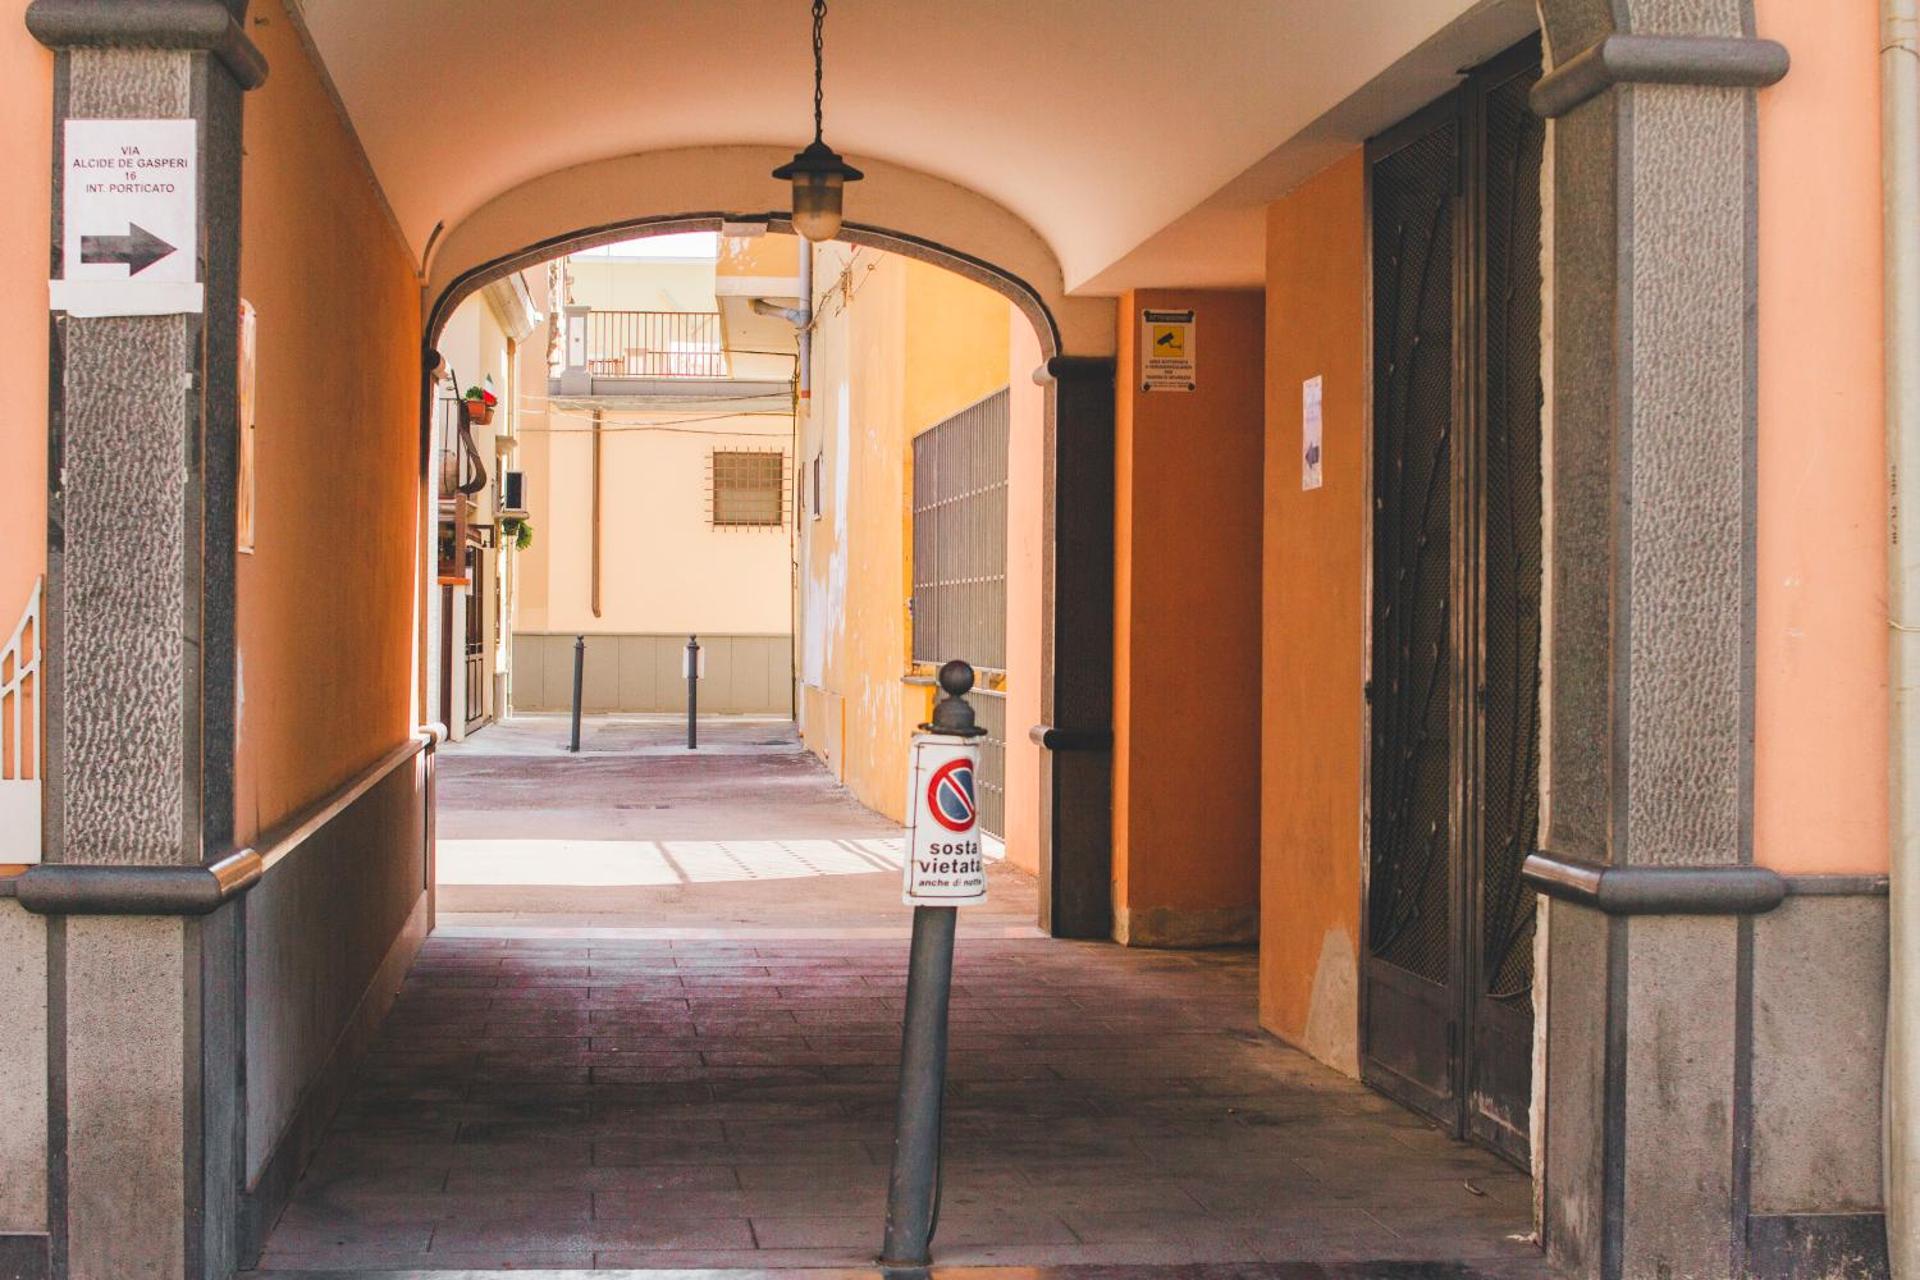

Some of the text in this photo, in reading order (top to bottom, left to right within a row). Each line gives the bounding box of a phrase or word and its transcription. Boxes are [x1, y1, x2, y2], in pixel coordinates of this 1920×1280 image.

[121, 146, 140, 155] VIA
[73, 159, 188, 168] ALCIDE DE GASPERI
[125, 171, 137, 181] 16
[86, 183, 175, 193] INT. PORTICATO
[929, 840, 978, 855] sosta
[919, 879, 950, 887] anche
